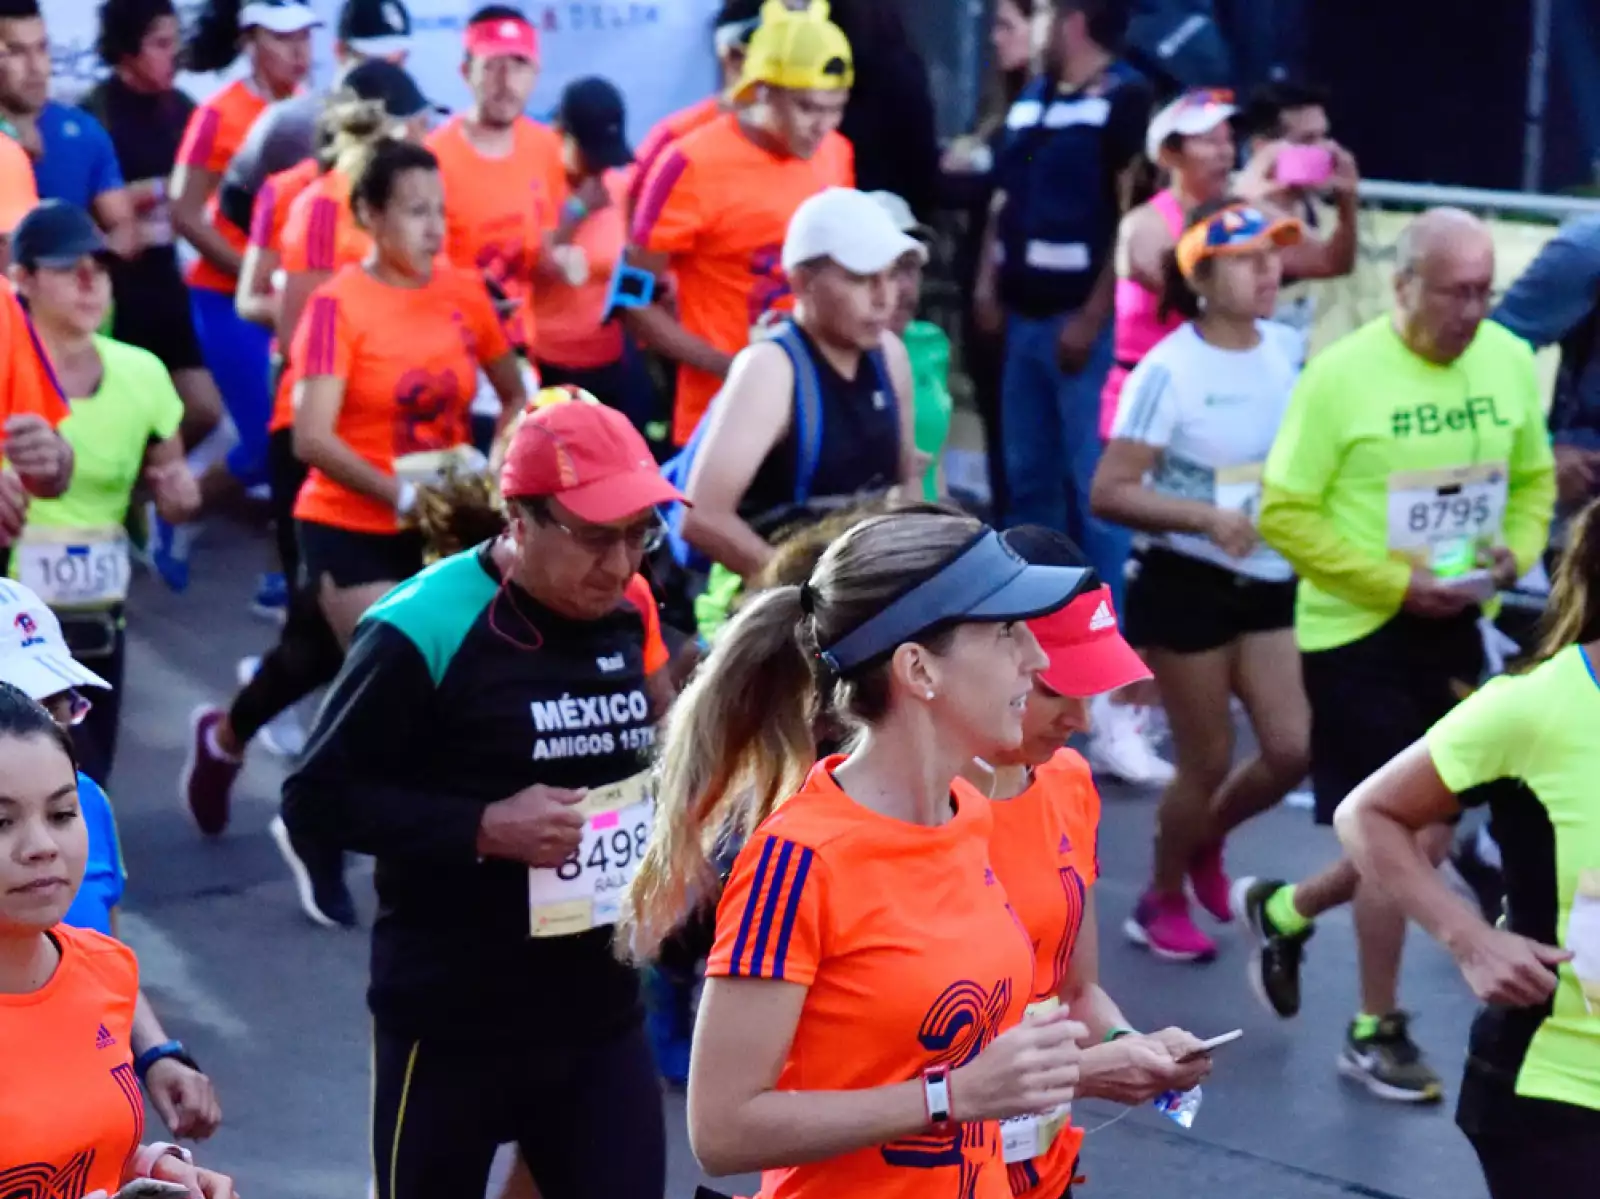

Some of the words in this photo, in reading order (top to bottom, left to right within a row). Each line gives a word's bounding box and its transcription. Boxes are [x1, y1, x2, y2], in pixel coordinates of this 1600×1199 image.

[1391, 396, 1510, 438] #BeFL
[1408, 494, 1491, 533] 8795
[530, 690, 647, 732] MÉXICO
[532, 732, 615, 761] AMIGOS
